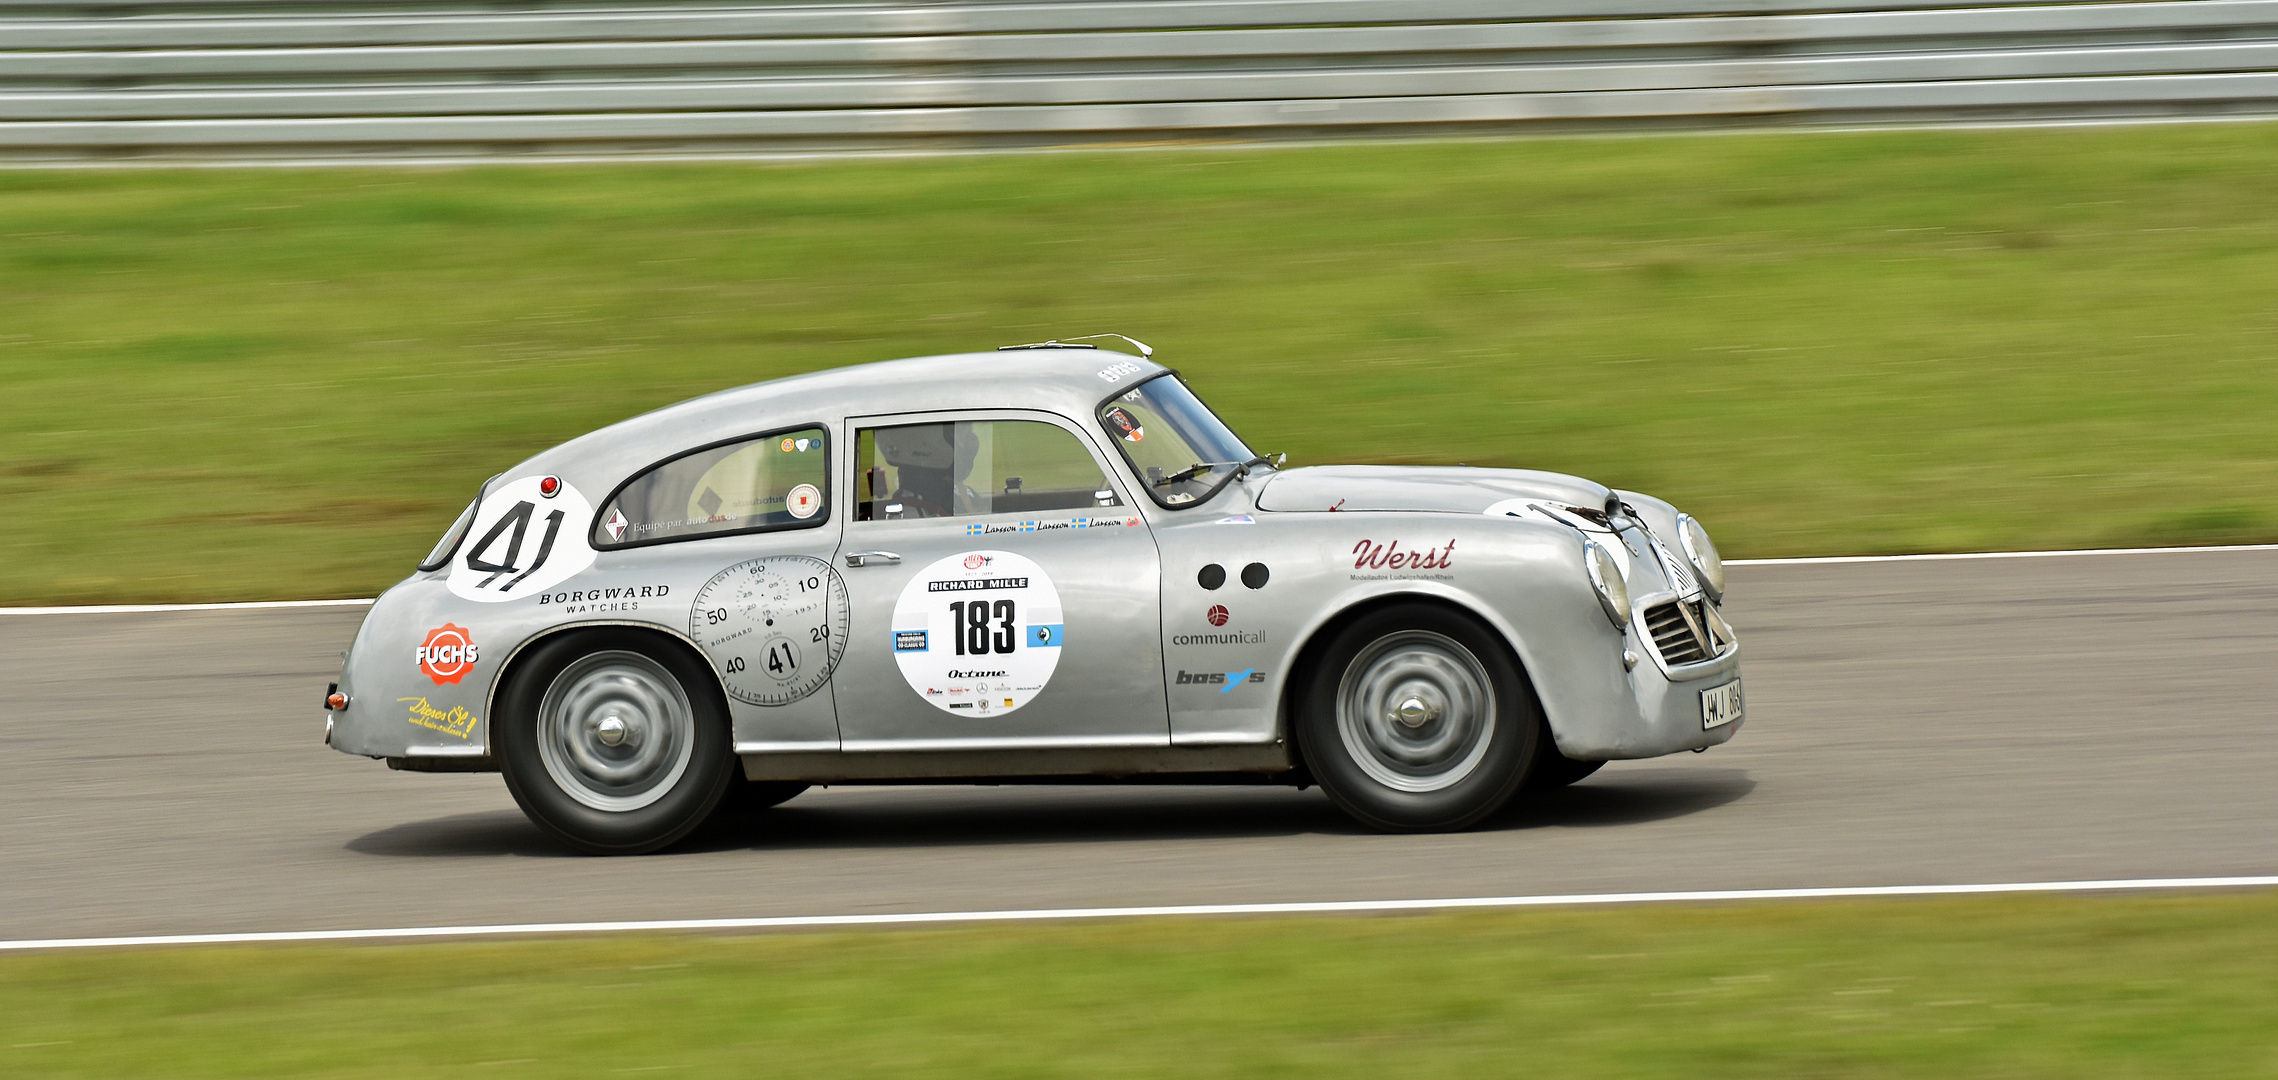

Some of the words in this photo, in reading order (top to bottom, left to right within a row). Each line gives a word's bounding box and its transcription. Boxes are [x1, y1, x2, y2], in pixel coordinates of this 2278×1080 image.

[667, 518, 682, 530] par
[984, 523, 1017, 534] Larsson
[1036, 520, 1069, 531] Larsson
[1088, 517, 1121, 528] Larsson
[467, 501, 565, 592] 41
[1352, 538, 1456, 570] Werst
[750, 565, 765, 574] 60
[798, 576, 819, 593] 10
[930, 580, 984, 591] RICHARD
[989, 577, 1027, 589] MILLE
[539, 585, 670, 605] BORGWARD
[566, 601, 639, 614] WATCHES
[707, 607, 728, 626] 50
[711, 627, 753, 647] BORGWARD
[810, 624, 830, 643] 20
[949, 599, 1016, 656] 183
[1173, 629, 1266, 646] communicall
[416, 644, 479, 665] FUCHS
[768, 642, 796, 674] 41
[726, 656, 746, 674] 40
[948, 668, 1008, 679] Octane
[403, 697, 447, 721] Dieses
